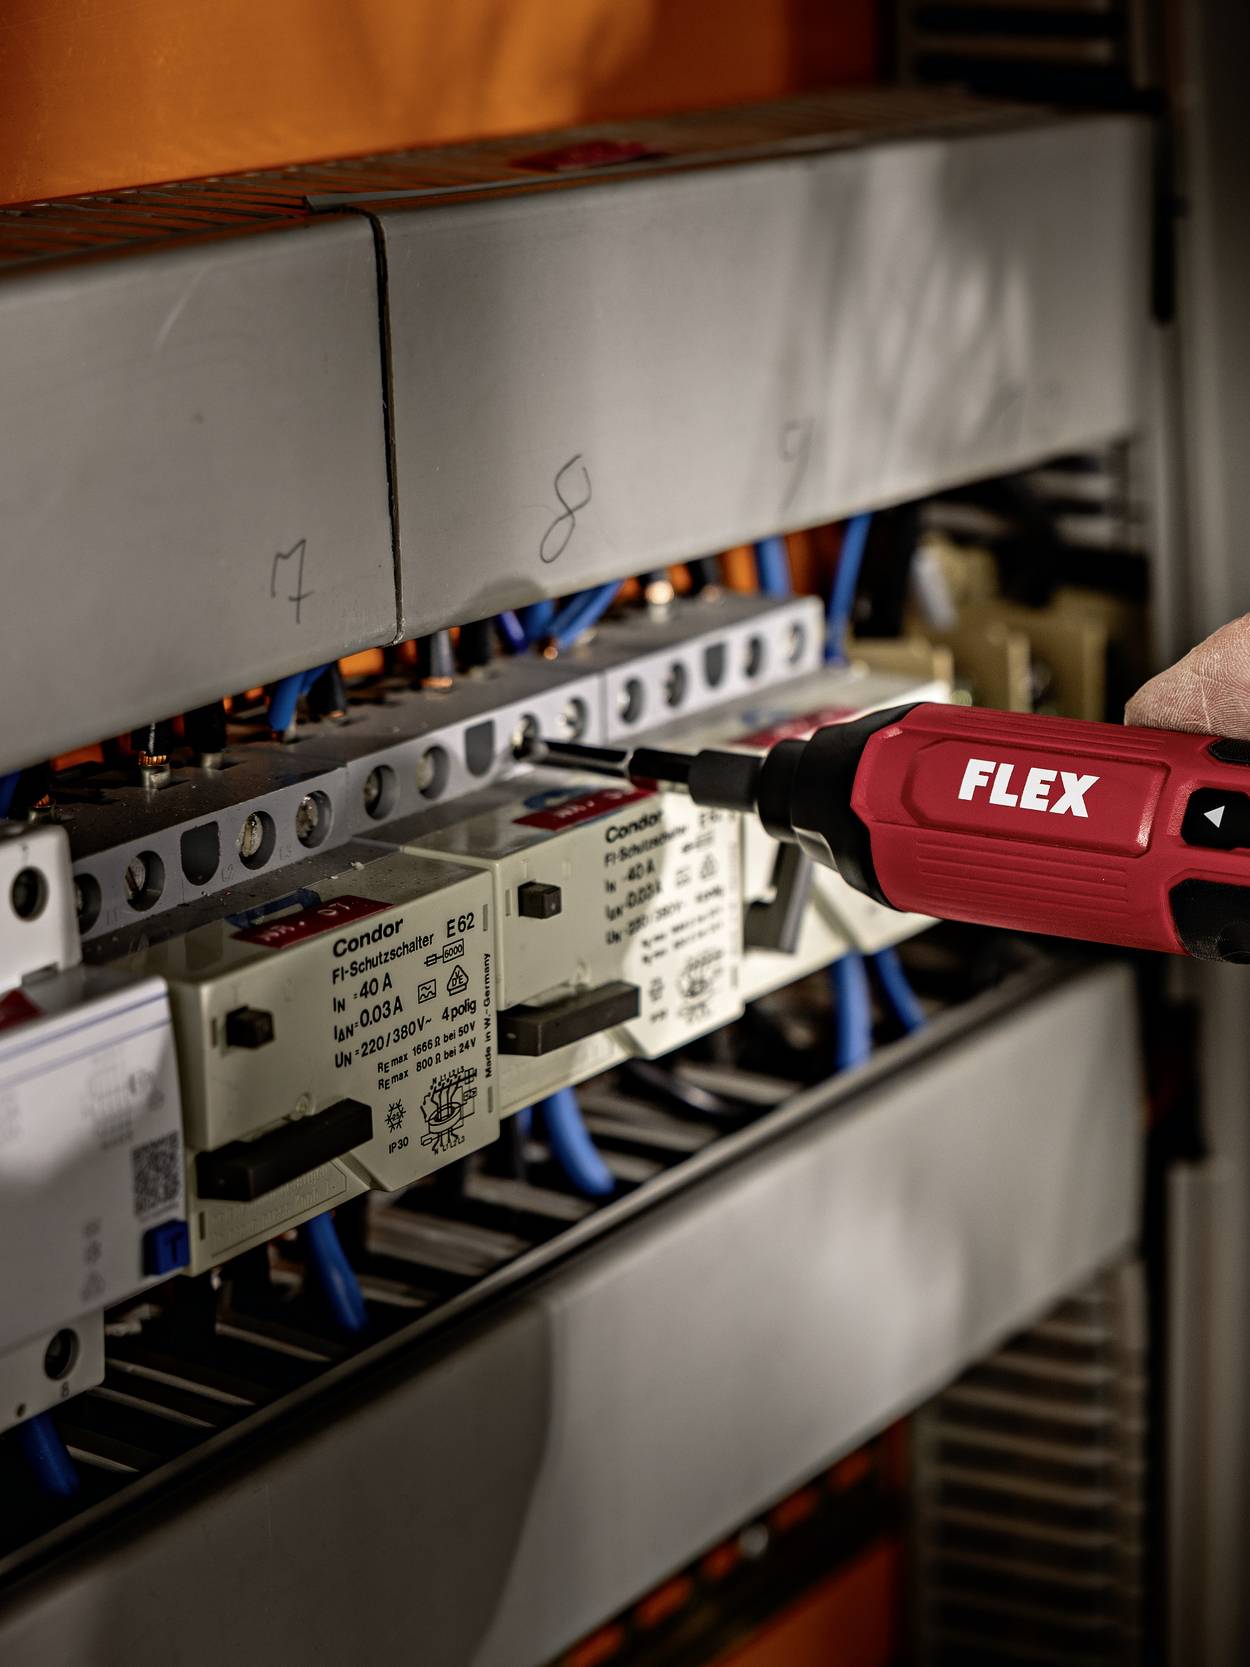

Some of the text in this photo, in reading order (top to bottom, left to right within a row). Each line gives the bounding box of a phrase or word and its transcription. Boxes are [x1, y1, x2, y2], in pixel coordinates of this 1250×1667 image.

[539, 453, 592, 564] 8
[271, 538, 314, 624] 7
[958, 758, 1101, 818] FLEX
[605, 810, 664, 844] Condor
[332, 917, 404, 958] Condor
[444, 943, 463, 959] 6000
[331, 932, 435, 986] FI-Schutzschalter
[382, 972, 393, 992] A
[390, 1053, 409, 1068] max
[412, 1039, 433, 1057] 1666
[443, 1030, 456, 1044] bei
[484, 1031, 491, 1042] in
[391, 1069, 409, 1084] max
[415, 1056, 433, 1073] 800
[443, 1046, 457, 1060] bei
[484, 1047, 492, 1079] Made
